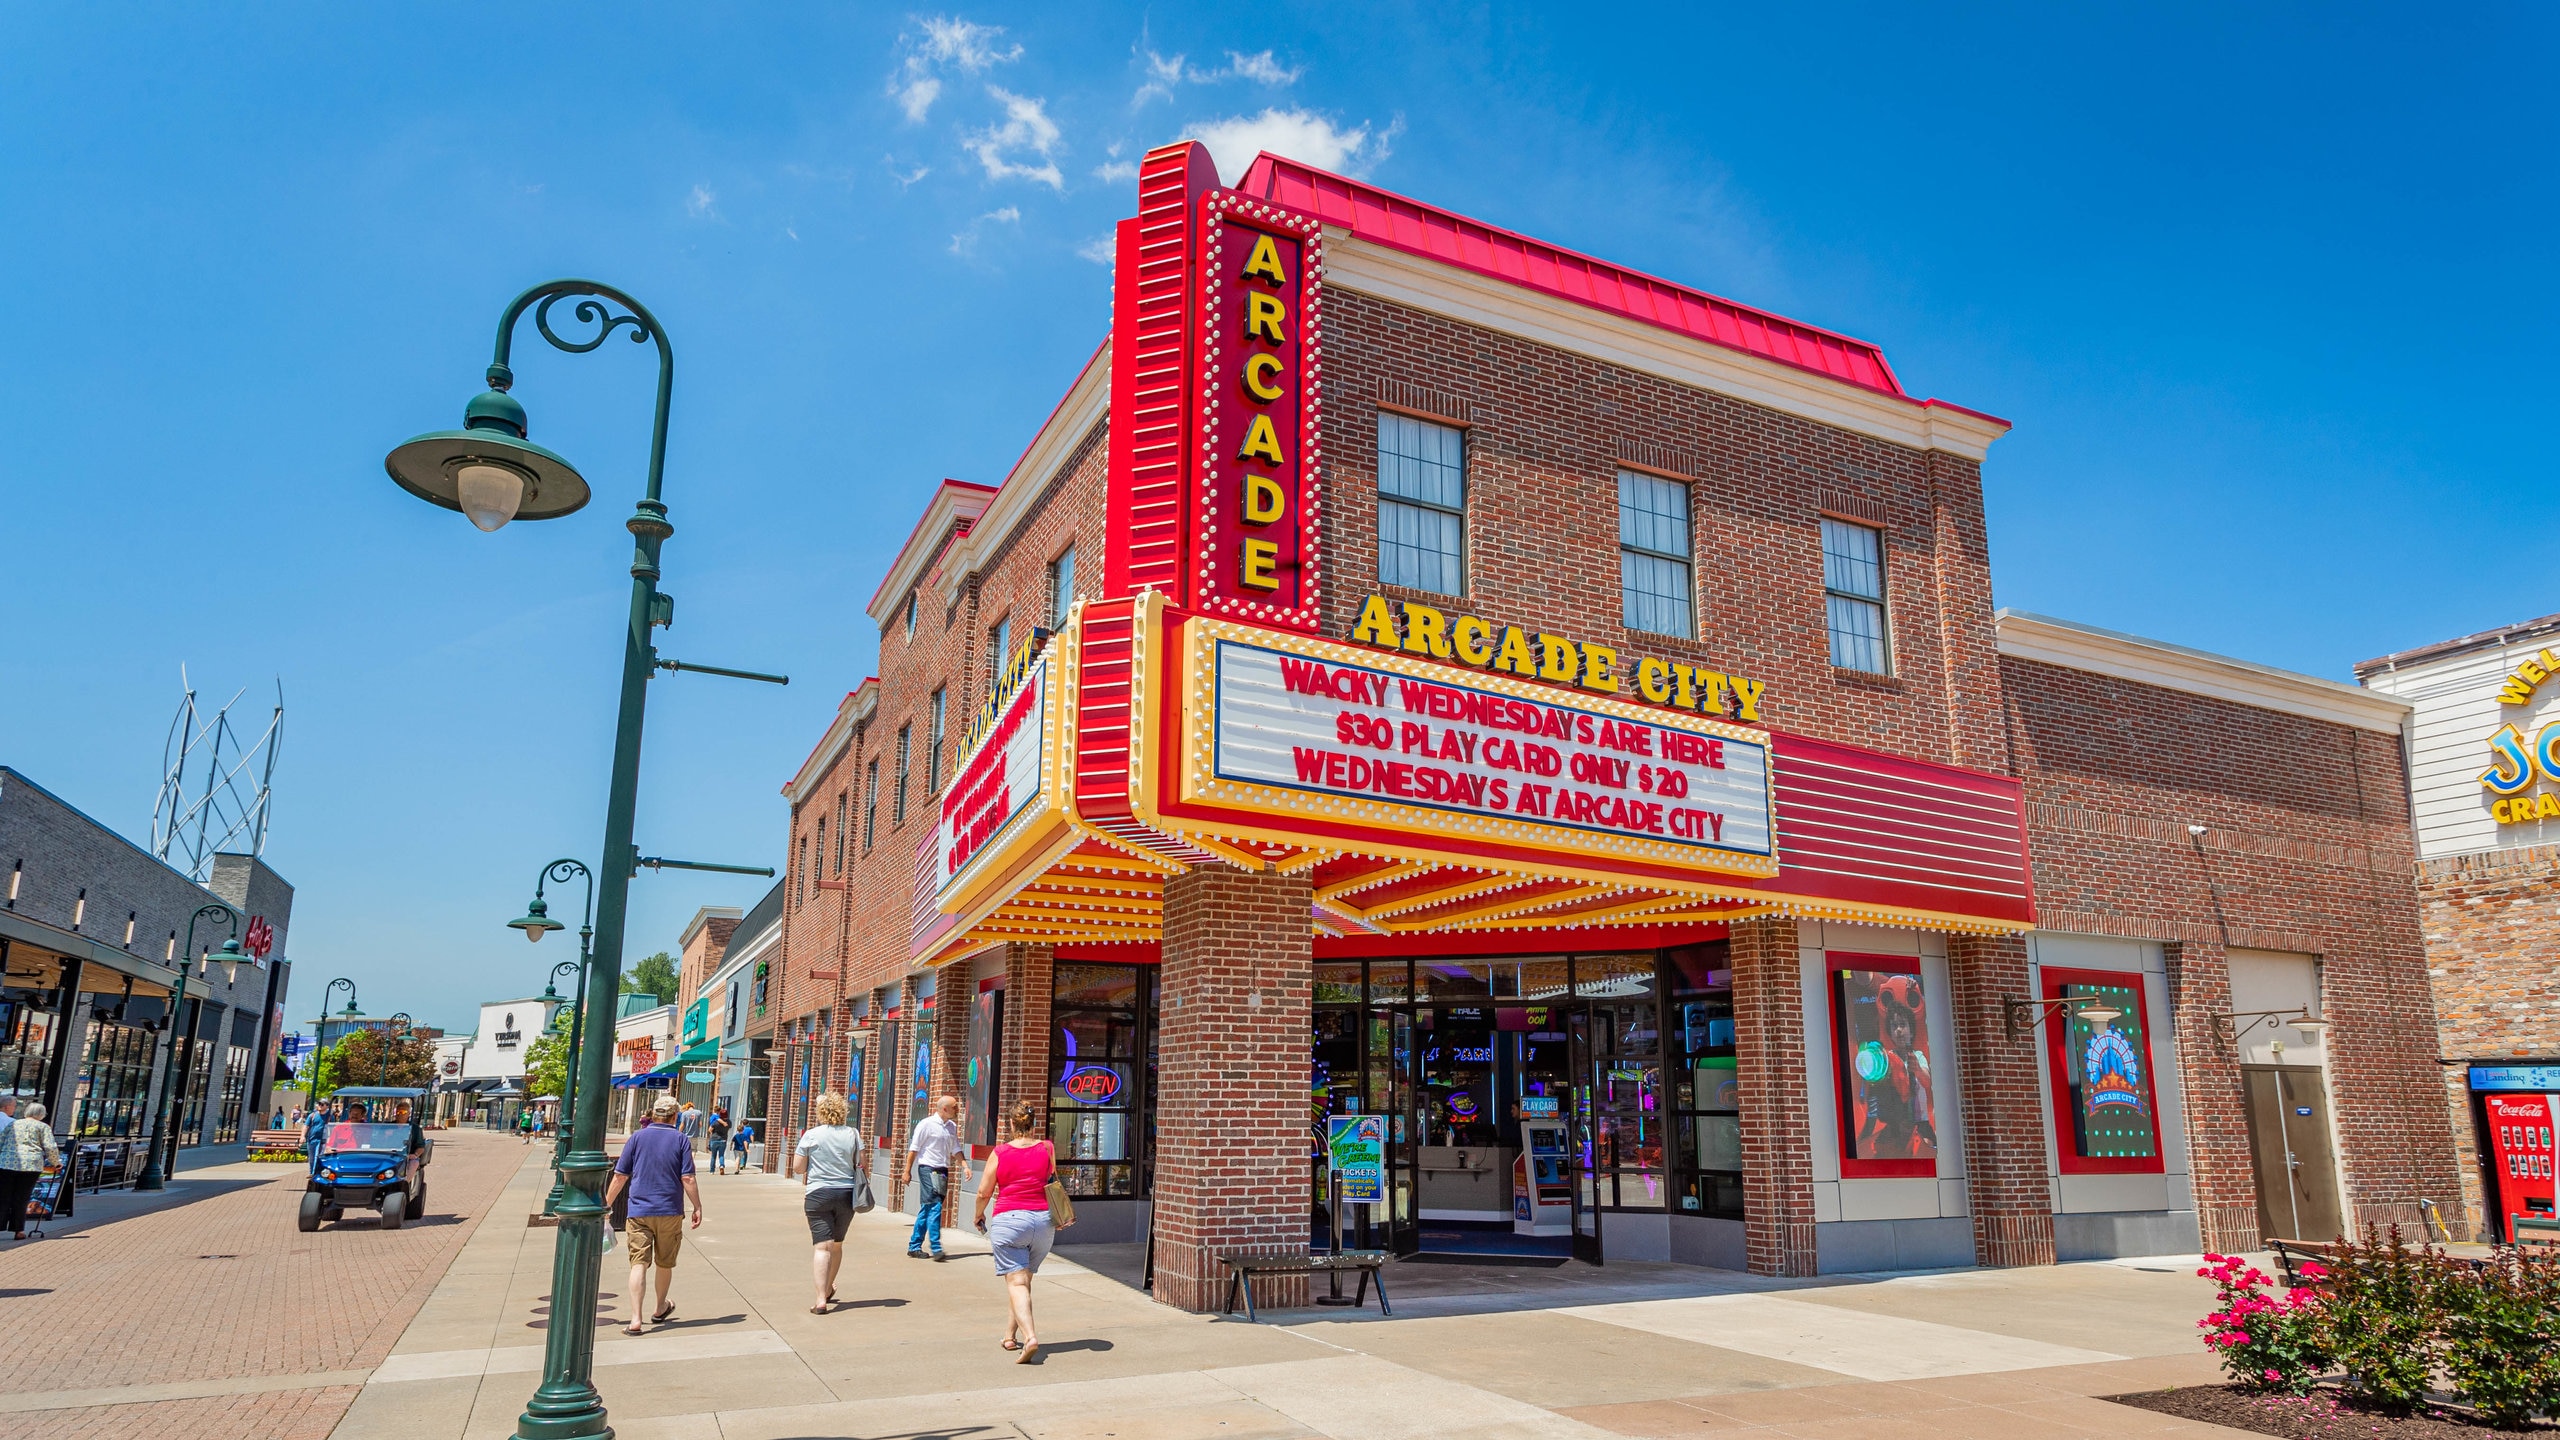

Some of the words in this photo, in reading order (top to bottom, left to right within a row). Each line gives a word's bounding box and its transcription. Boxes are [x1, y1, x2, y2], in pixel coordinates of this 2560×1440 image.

[1238, 234, 1287, 591] ARCADE
[1347, 594, 1618, 695] ARCADE
[1629, 657, 1765, 723] CITY
[1279, 656, 1389, 707] WACKY
[1400, 679, 1595, 742] WEDNESDAYS
[1599, 717, 1652, 759] ARE
[1661, 728, 1725, 770] HERE
[1336, 710, 1394, 750] $30
[1401, 721, 1477, 764] PLAY
[1482, 736, 1562, 777] CARD
[1569, 752, 1630, 790] ONLY
[1292, 746, 1508, 810] WEDNESDAYS
[1514, 782, 1553, 817] AT
[1554, 788, 1663, 835] ARCADE
[1669, 806, 1725, 842] CITY
[635, 1051, 655, 1059] RACK
[1068, 1075, 1117, 1095] OPEN
[2484, 1069, 2525, 1085] Landing
[2546, 1069, 2560, 1078] RE
[1522, 1101, 1539, 1110] PLAY
[1540, 1101, 1558, 1110] CARD
[2094, 1092, 2121, 1104] ARCADE
[2121, 1093, 2138, 1104] CITY
[2498, 1104, 2544, 1117] Coca-Cola
